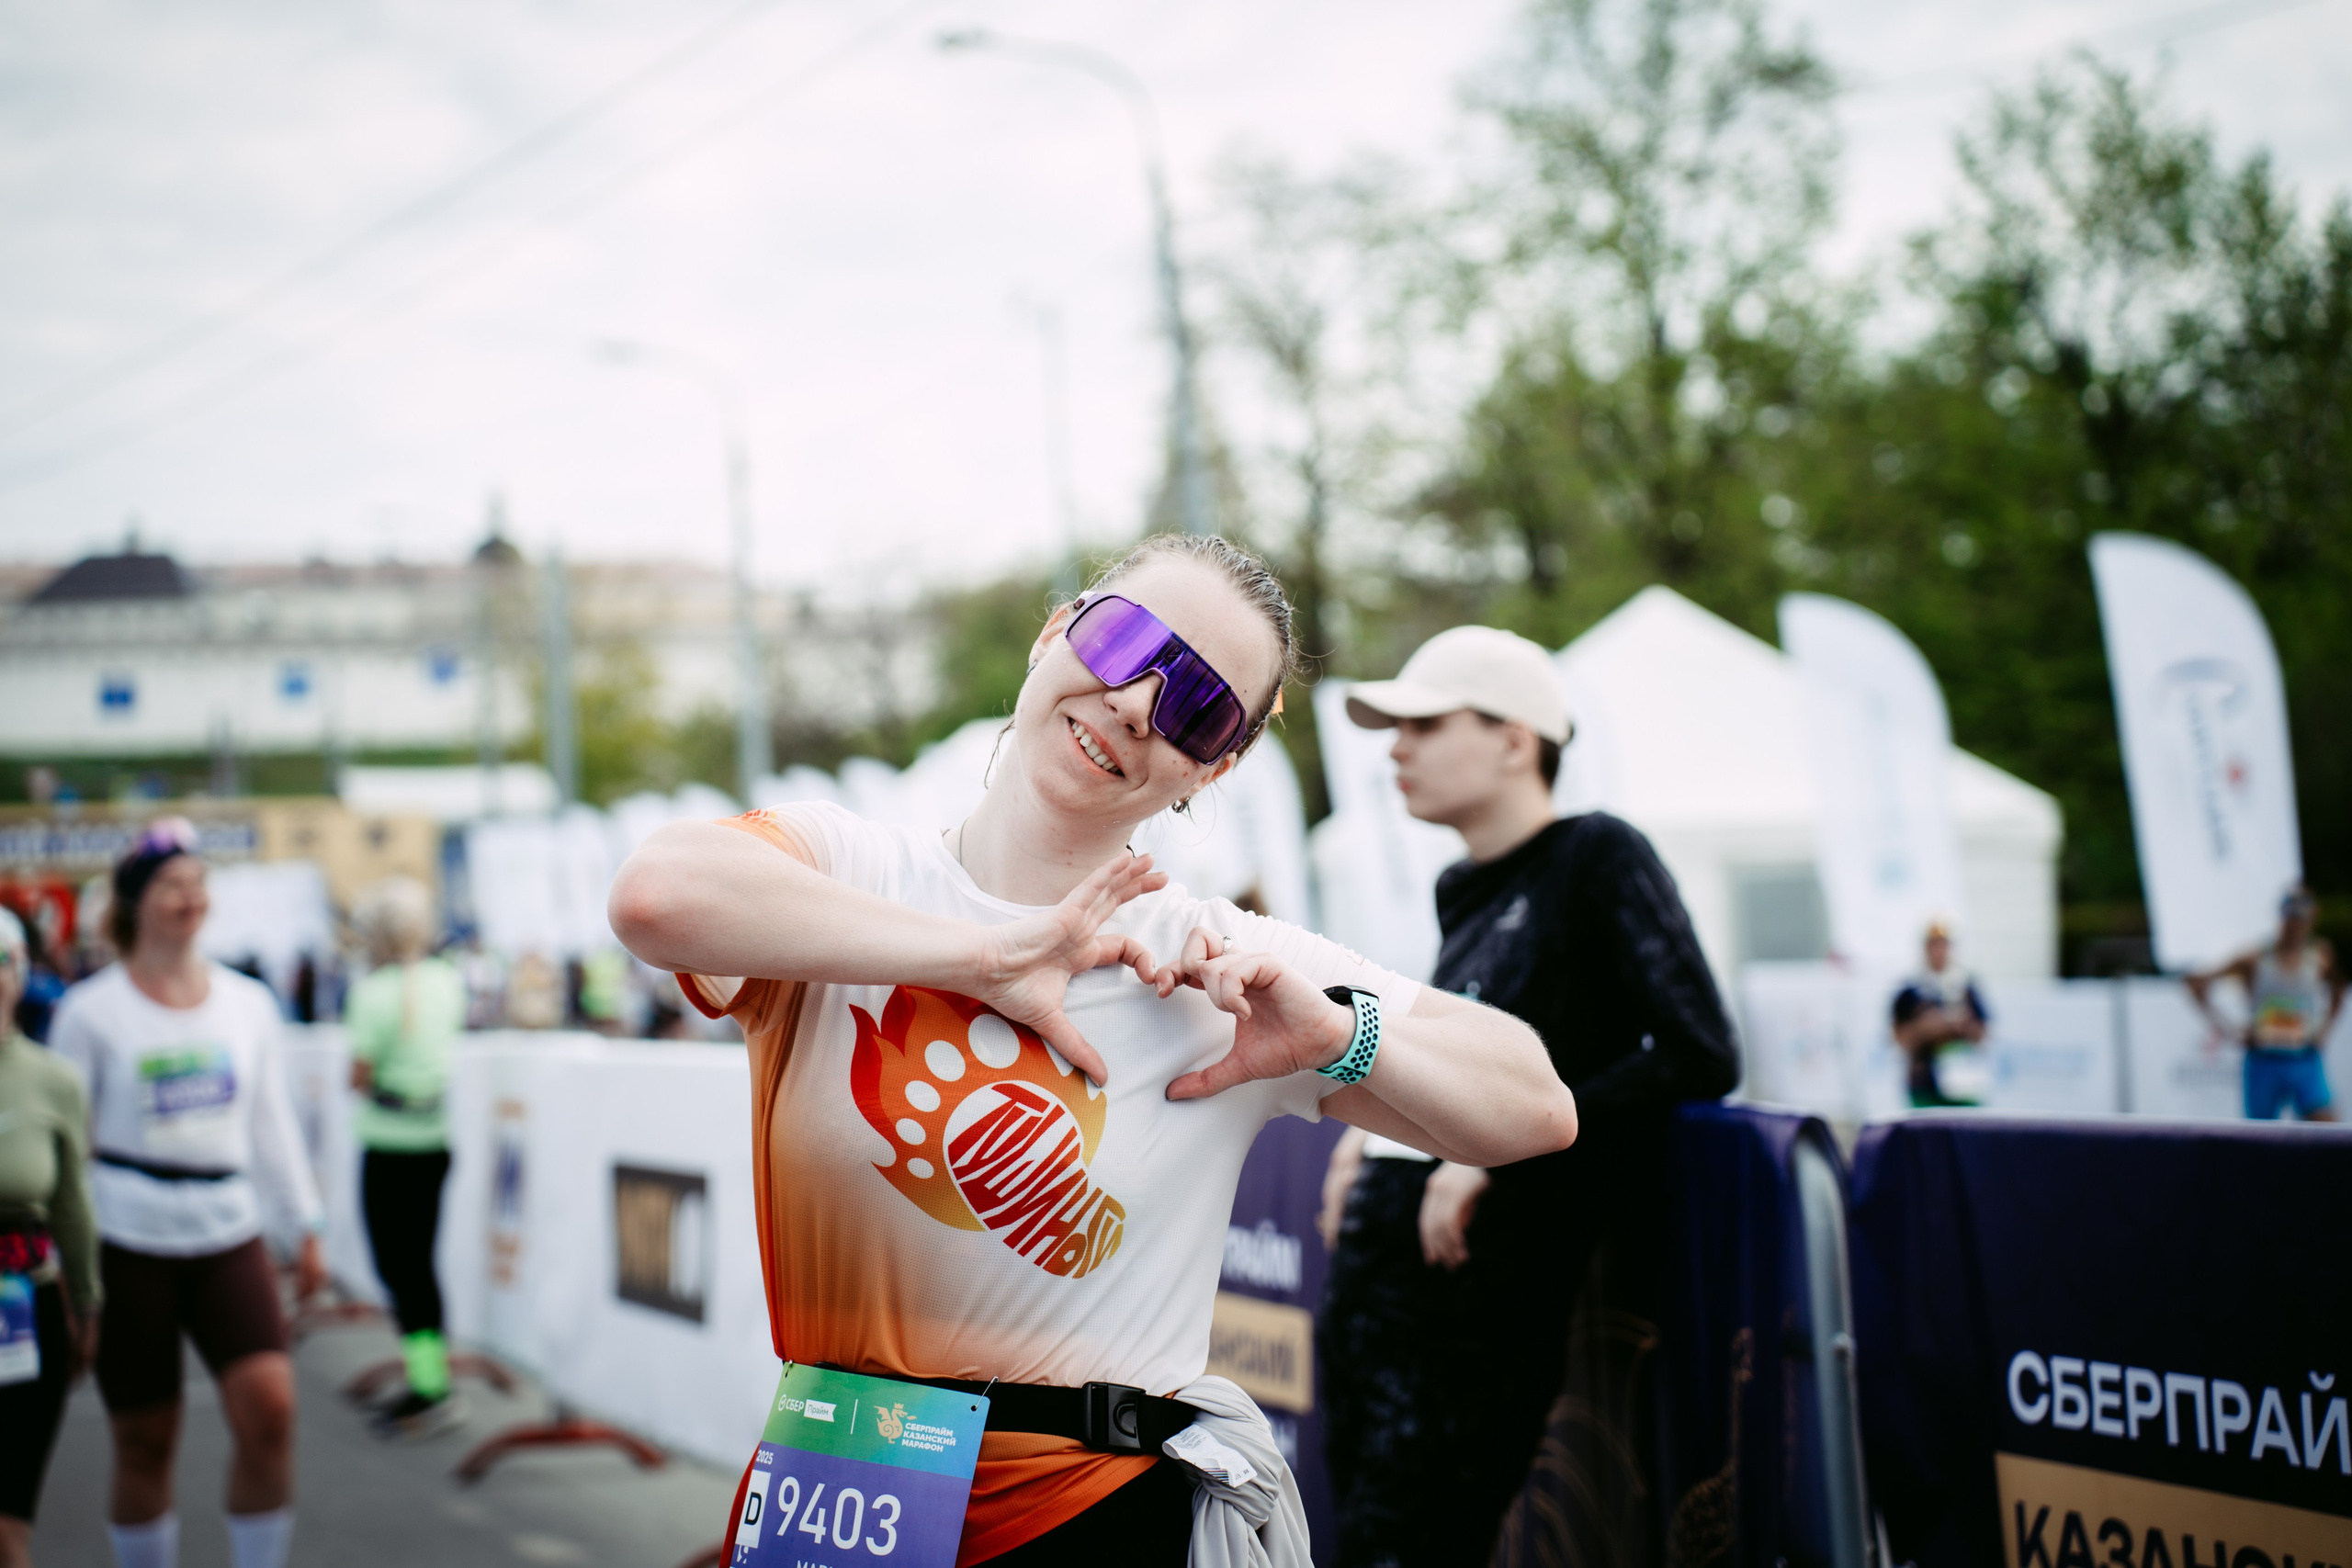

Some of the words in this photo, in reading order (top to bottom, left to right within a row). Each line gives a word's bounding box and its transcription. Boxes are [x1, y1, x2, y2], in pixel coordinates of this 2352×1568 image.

[807, 1404, 829, 1416] Прайм
[905, 1422, 954, 1438] СБЕРПРАЙМ
[901, 1438, 944, 1452] МАРАФОН
[903, 1430, 956, 1447] КАЗАНСКИЙ
[755, 1450, 774, 1465] 2025
[744, 1491, 762, 1526] D
[776, 1476, 901, 1556] 9403
